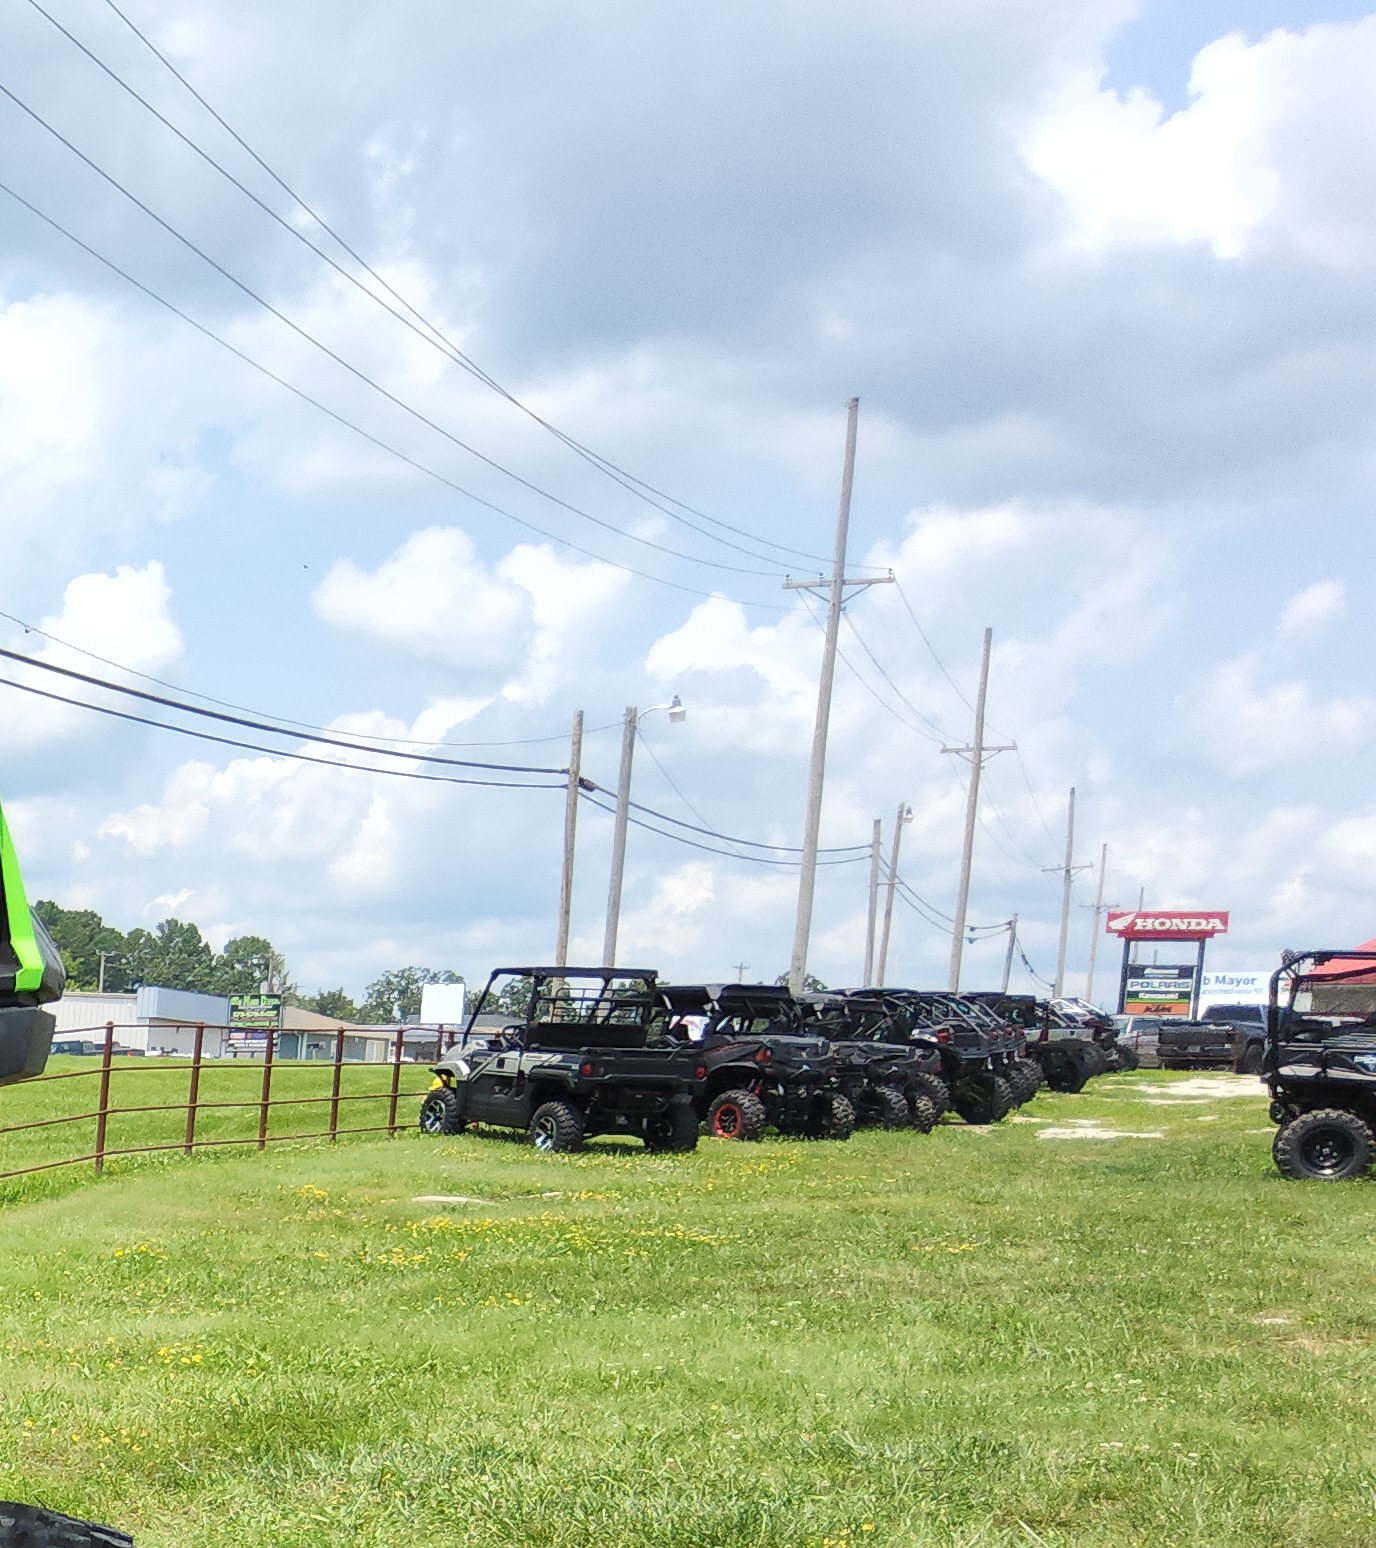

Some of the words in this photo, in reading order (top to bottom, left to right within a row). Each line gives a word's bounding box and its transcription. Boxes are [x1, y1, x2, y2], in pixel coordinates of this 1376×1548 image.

[1134, 918, 1225, 931] HONDA
[1130, 981, 1190, 989] POLARIS
[1215, 975, 1258, 987] Mayer
